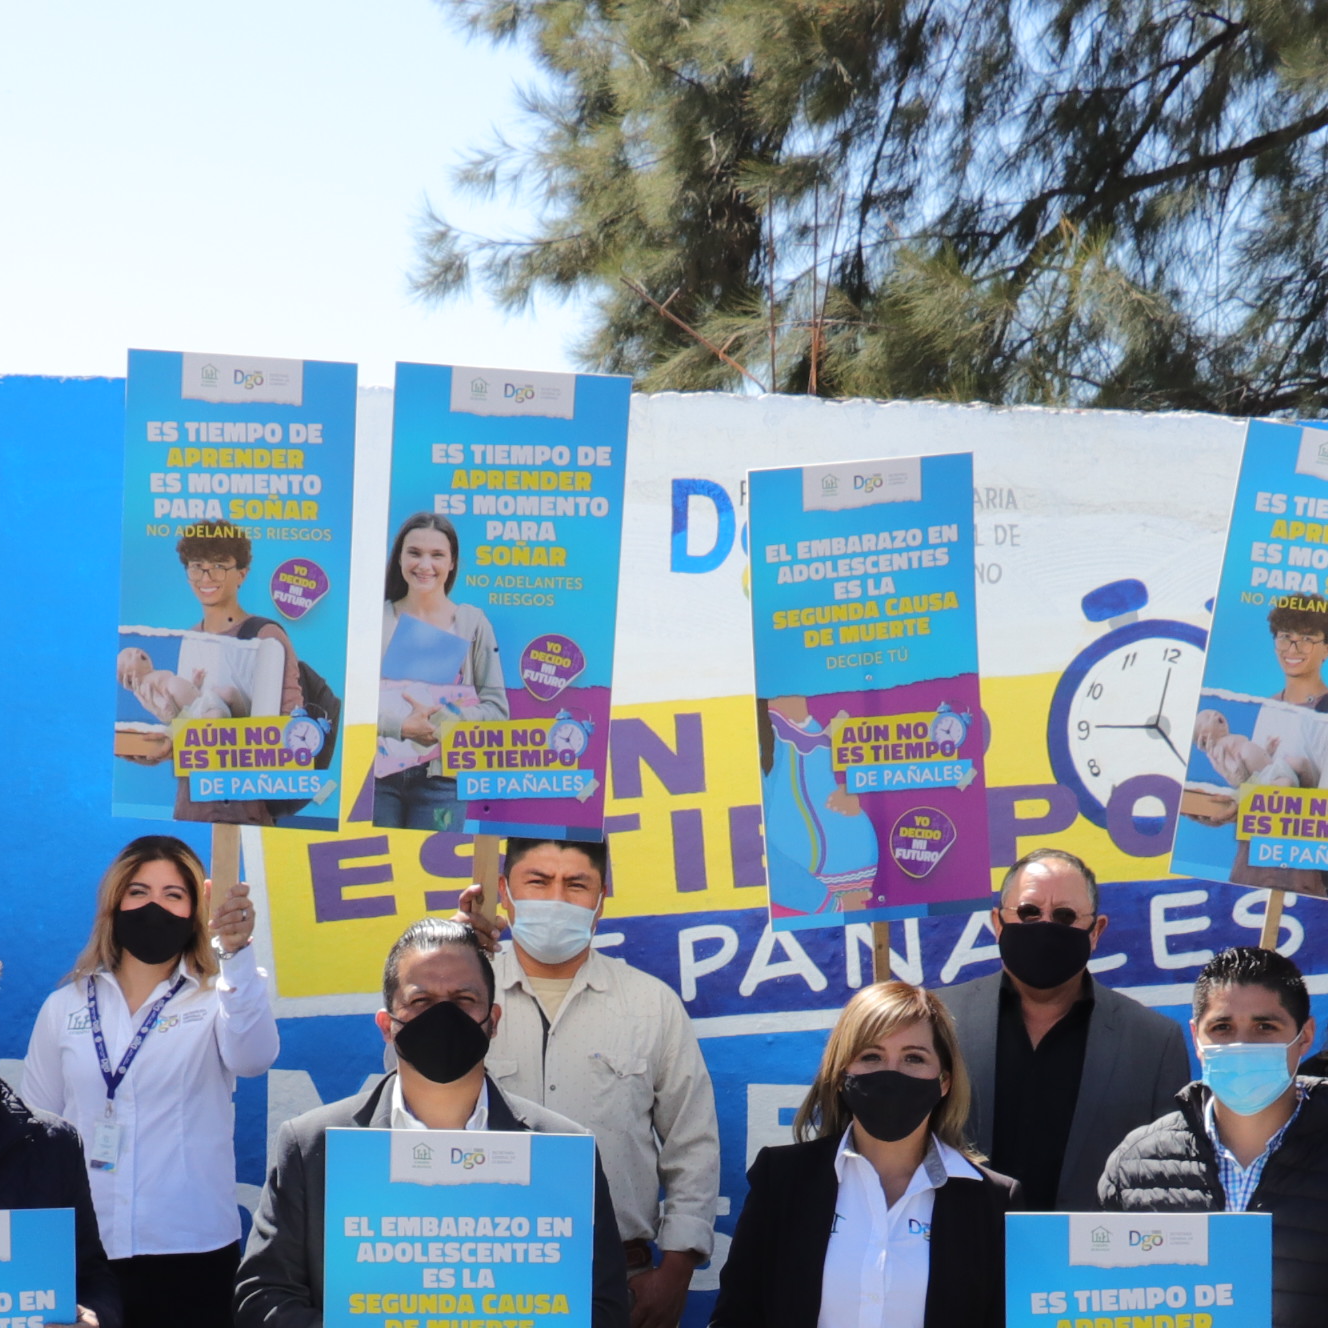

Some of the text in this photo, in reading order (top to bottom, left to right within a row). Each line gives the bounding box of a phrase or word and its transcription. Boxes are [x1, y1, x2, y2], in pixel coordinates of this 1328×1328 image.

[431, 443, 612, 466] ES TIEMPO DE
[451, 469, 592, 491] APRENDER
[153, 494, 318, 520] PARA SOÑAR
[433, 493, 609, 518] ES MOMENTO
[145, 524, 332, 541] NO ADELANTES RIESGOS
[763, 542, 790, 563] EL
[794, 527, 920, 559] EMBARAZO
[925, 523, 956, 544] EN
[994, 524, 1021, 547] DE
[1249, 541, 1283, 564] ES
[292, 564, 308, 577] YO
[775, 547, 948, 584] ADOLESCENTES
[278, 573, 317, 589] DECIDO
[833, 576, 894, 600] ES LA
[1249, 566, 1319, 593] PARA
[272, 591, 312, 608] FUTURO
[288, 586, 303, 597] MI
[826, 645, 909, 670] DECIDE TÚ
[1162, 647, 1182, 664] 12
[1086, 681, 1104, 700] 10
[1077, 720, 1090, 740] 9
[1087, 758, 1101, 777] 8
[465, 770, 585, 795] DE PAÑALES
[1248, 791, 1303, 816] AÚN
[1239, 814, 1274, 835] ES
[343, 1216, 573, 1237] EL EMBARAZO EN
[356, 1243, 561, 1263] ADOLESCENTES
